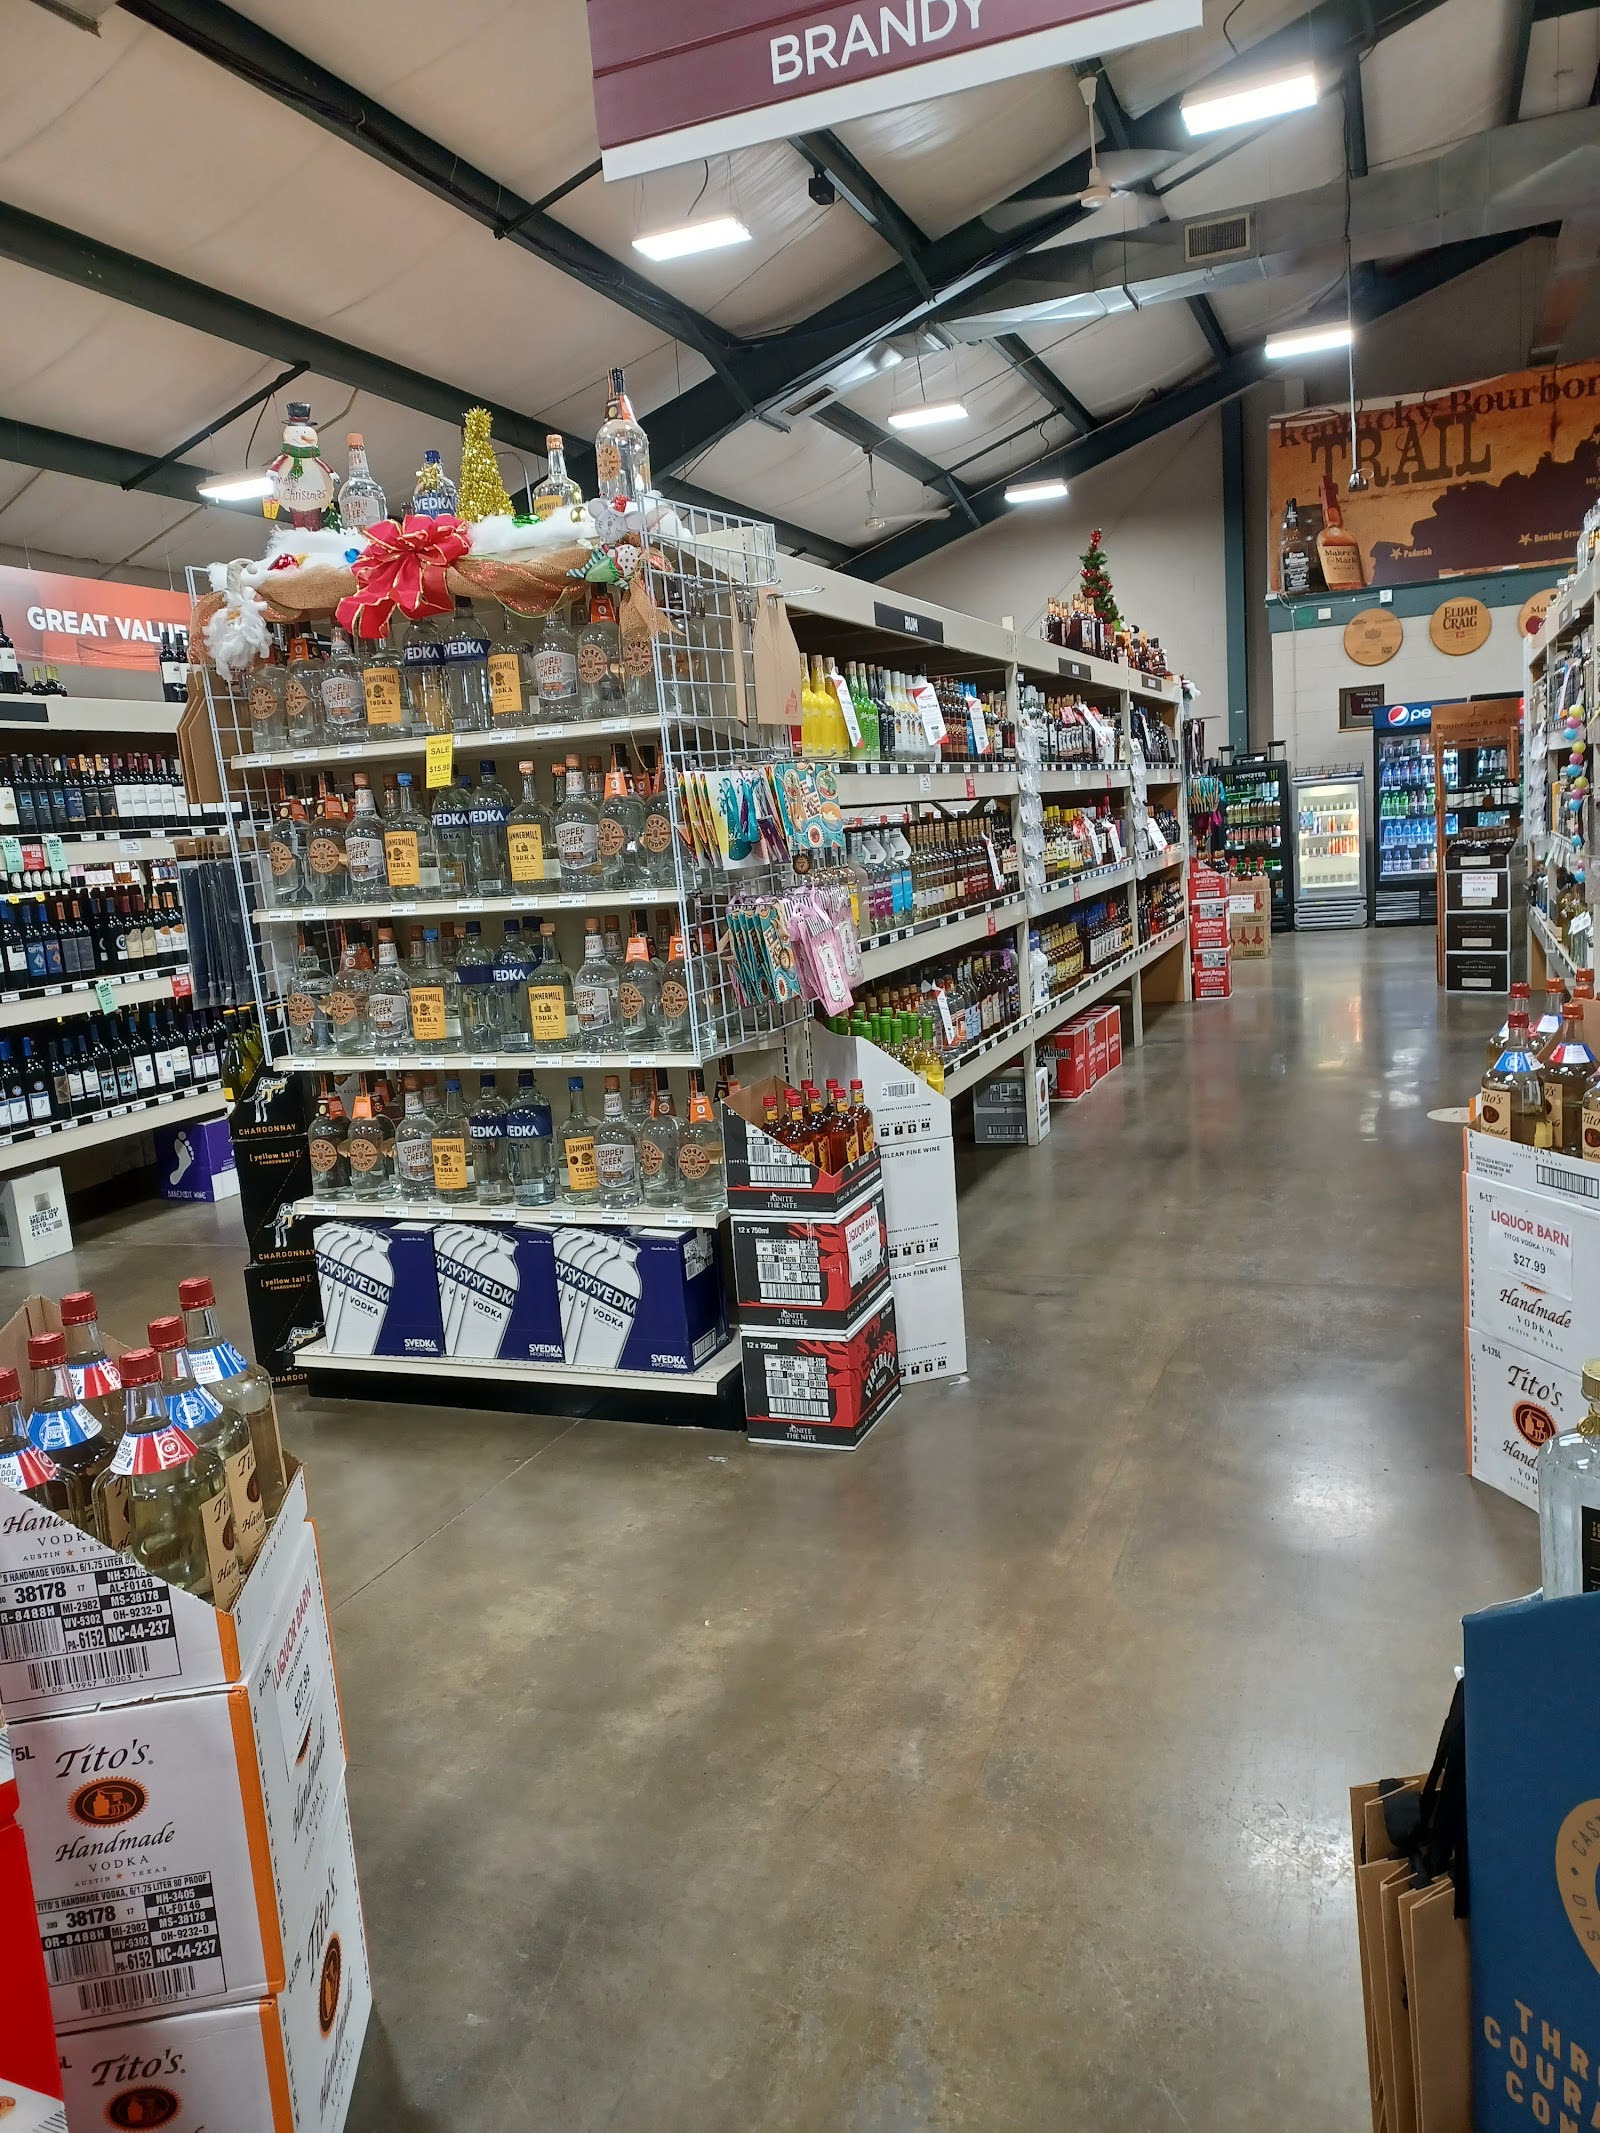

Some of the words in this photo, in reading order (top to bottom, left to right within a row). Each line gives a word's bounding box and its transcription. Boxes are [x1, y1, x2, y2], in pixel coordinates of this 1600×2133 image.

[769, 0, 986, 86] BRANDY
[1311, 413, 1491, 488] TRAIL
[283, 488, 327, 501] Christmas
[413, 497, 451, 511] SVEDKA
[1534, 532, 1562, 543] Bowling
[26, 605, 113, 637] GREAT
[1444, 606, 1478, 618] ELIJAH
[904, 615, 919, 633] RUM
[1443, 616, 1478, 630] CRAIG
[430, 746, 450, 755] SALE
[1481, 1090, 1502, 1104] Tito's
[238, 1123, 296, 1136] CHARDONNAY
[598, 1147, 624, 1158] COPPER
[906, 1148, 921, 1156] FINE
[923, 1145, 941, 1153] WINE
[769, 1193, 793, 1202] IGNITE
[30, 1210, 58, 1225] MERLOT
[751, 1226, 769, 1234] 750ml
[847, 1220, 866, 1244] LIQUOR
[865, 1213, 878, 1231] BARN
[1491, 1210, 1534, 1236] LIQUOR
[1537, 1224, 1570, 1248] BARN
[1504, 1232, 1520, 1243] TITOS
[1521, 1238, 1541, 1251] VODKA
[258, 1248, 316, 1261] CHARDONNAY
[859, 1249, 872, 1267] $14.99
[1513, 1252, 1546, 1275] $27.99
[913, 1268, 928, 1277] FINE
[930, 1264, 947, 1273] WINE
[350, 1295, 379, 1316] VODKA
[472, 1299, 502, 1320] VODKA
[780, 1310, 804, 1319] IGNITE
[1499, 1288, 1572, 1329] Handmade
[593, 1306, 624, 1329] VODKA
[1517, 1314, 1554, 1338] VODKA
[404, 1339, 435, 1348] SVEDKA
[529, 1343, 562, 1353] SVEDKA
[760, 1342, 778, 1350] 750ml
[1508, 1325, 1530, 1338] AUSTIN
[1541, 1339, 1564, 1353] TEXAS
[651, 1354, 686, 1364] SVEDKA
[1482, 1343, 1502, 1359] 6-1.75L
[865, 1351, 896, 1398] FIREBALL
[1507, 1365, 1563, 1407] Tito's
[785, 1432, 800, 1440] THE
[800, 1433, 817, 1441] NITE
[789, 1424, 812, 1434] IGNITE
[164, 1443, 177, 1453] GF
[22, 1550, 61, 1562] AUSTIN
[9, 1567, 50, 1583] HANDMADE
[50, 1563, 78, 1576] VODKA,
[79, 1561, 103, 1574] 6/1.75
[104, 1557, 124, 1568] LITER
[14, 1582, 67, 1604] 38178
[109, 1579, 153, 1594] AL-F0146
[62, 1600, 99, 1614] MI-2982
[111, 1589, 159, 1607] MS-38178
[1, 1605, 56, 1624] R-8488H
[63, 1613, 101, 1629] WV-5302
[113, 1604, 163, 1621] OH-9232-D
[68, 1629, 105, 1651] PA-6152
[108, 1618, 171, 1644] NC-44-237
[275, 1617, 297, 1691] LIQUOR
[295, 1577, 311, 1630] BARN
[71, 1680, 97, 1690] 19947
[105, 1674, 132, 1685] 00003
[293, 1663, 311, 1717] $27.99
[54, 1738, 151, 1779] Tito's
[292, 1712, 326, 1845] Handmade
[54, 1821, 176, 1863] Handmade
[88, 1854, 149, 1873] VODKA
[73, 1876, 111, 1888] AUSTIN
[131, 1866, 167, 1877] TEXAS
[37, 1899, 60, 1912] TITO'S
[61, 1893, 99, 1908] HANDMADE
[101, 1888, 129, 1901] VODKA,
[129, 1885, 152, 1896] 6/1.75
[153, 1881, 172, 1891] LITER
[173, 1879, 182, 1888] 80
[183, 1875, 208, 1886] PROOF
[155, 1888, 195, 1904] NH-3405
[65, 1905, 116, 1929] 38178
[158, 1900, 201, 1916] AL-F0146
[159, 1911, 207, 1929] MS-38178
[307, 1866, 338, 1988] Tito's
[44, 1929, 105, 1948] OR-8488H
[111, 1922, 147, 1937] MI-2982
[161, 1924, 209, 1941] OH-9232-D
[112, 1935, 150, 1951] WV-5302
[156, 1939, 216, 1964] NC-44-237
[116, 1950, 152, 1972] PA-6152
[1514, 1999, 1600, 2087] THR
[91, 2048, 183, 2087] Tito's
